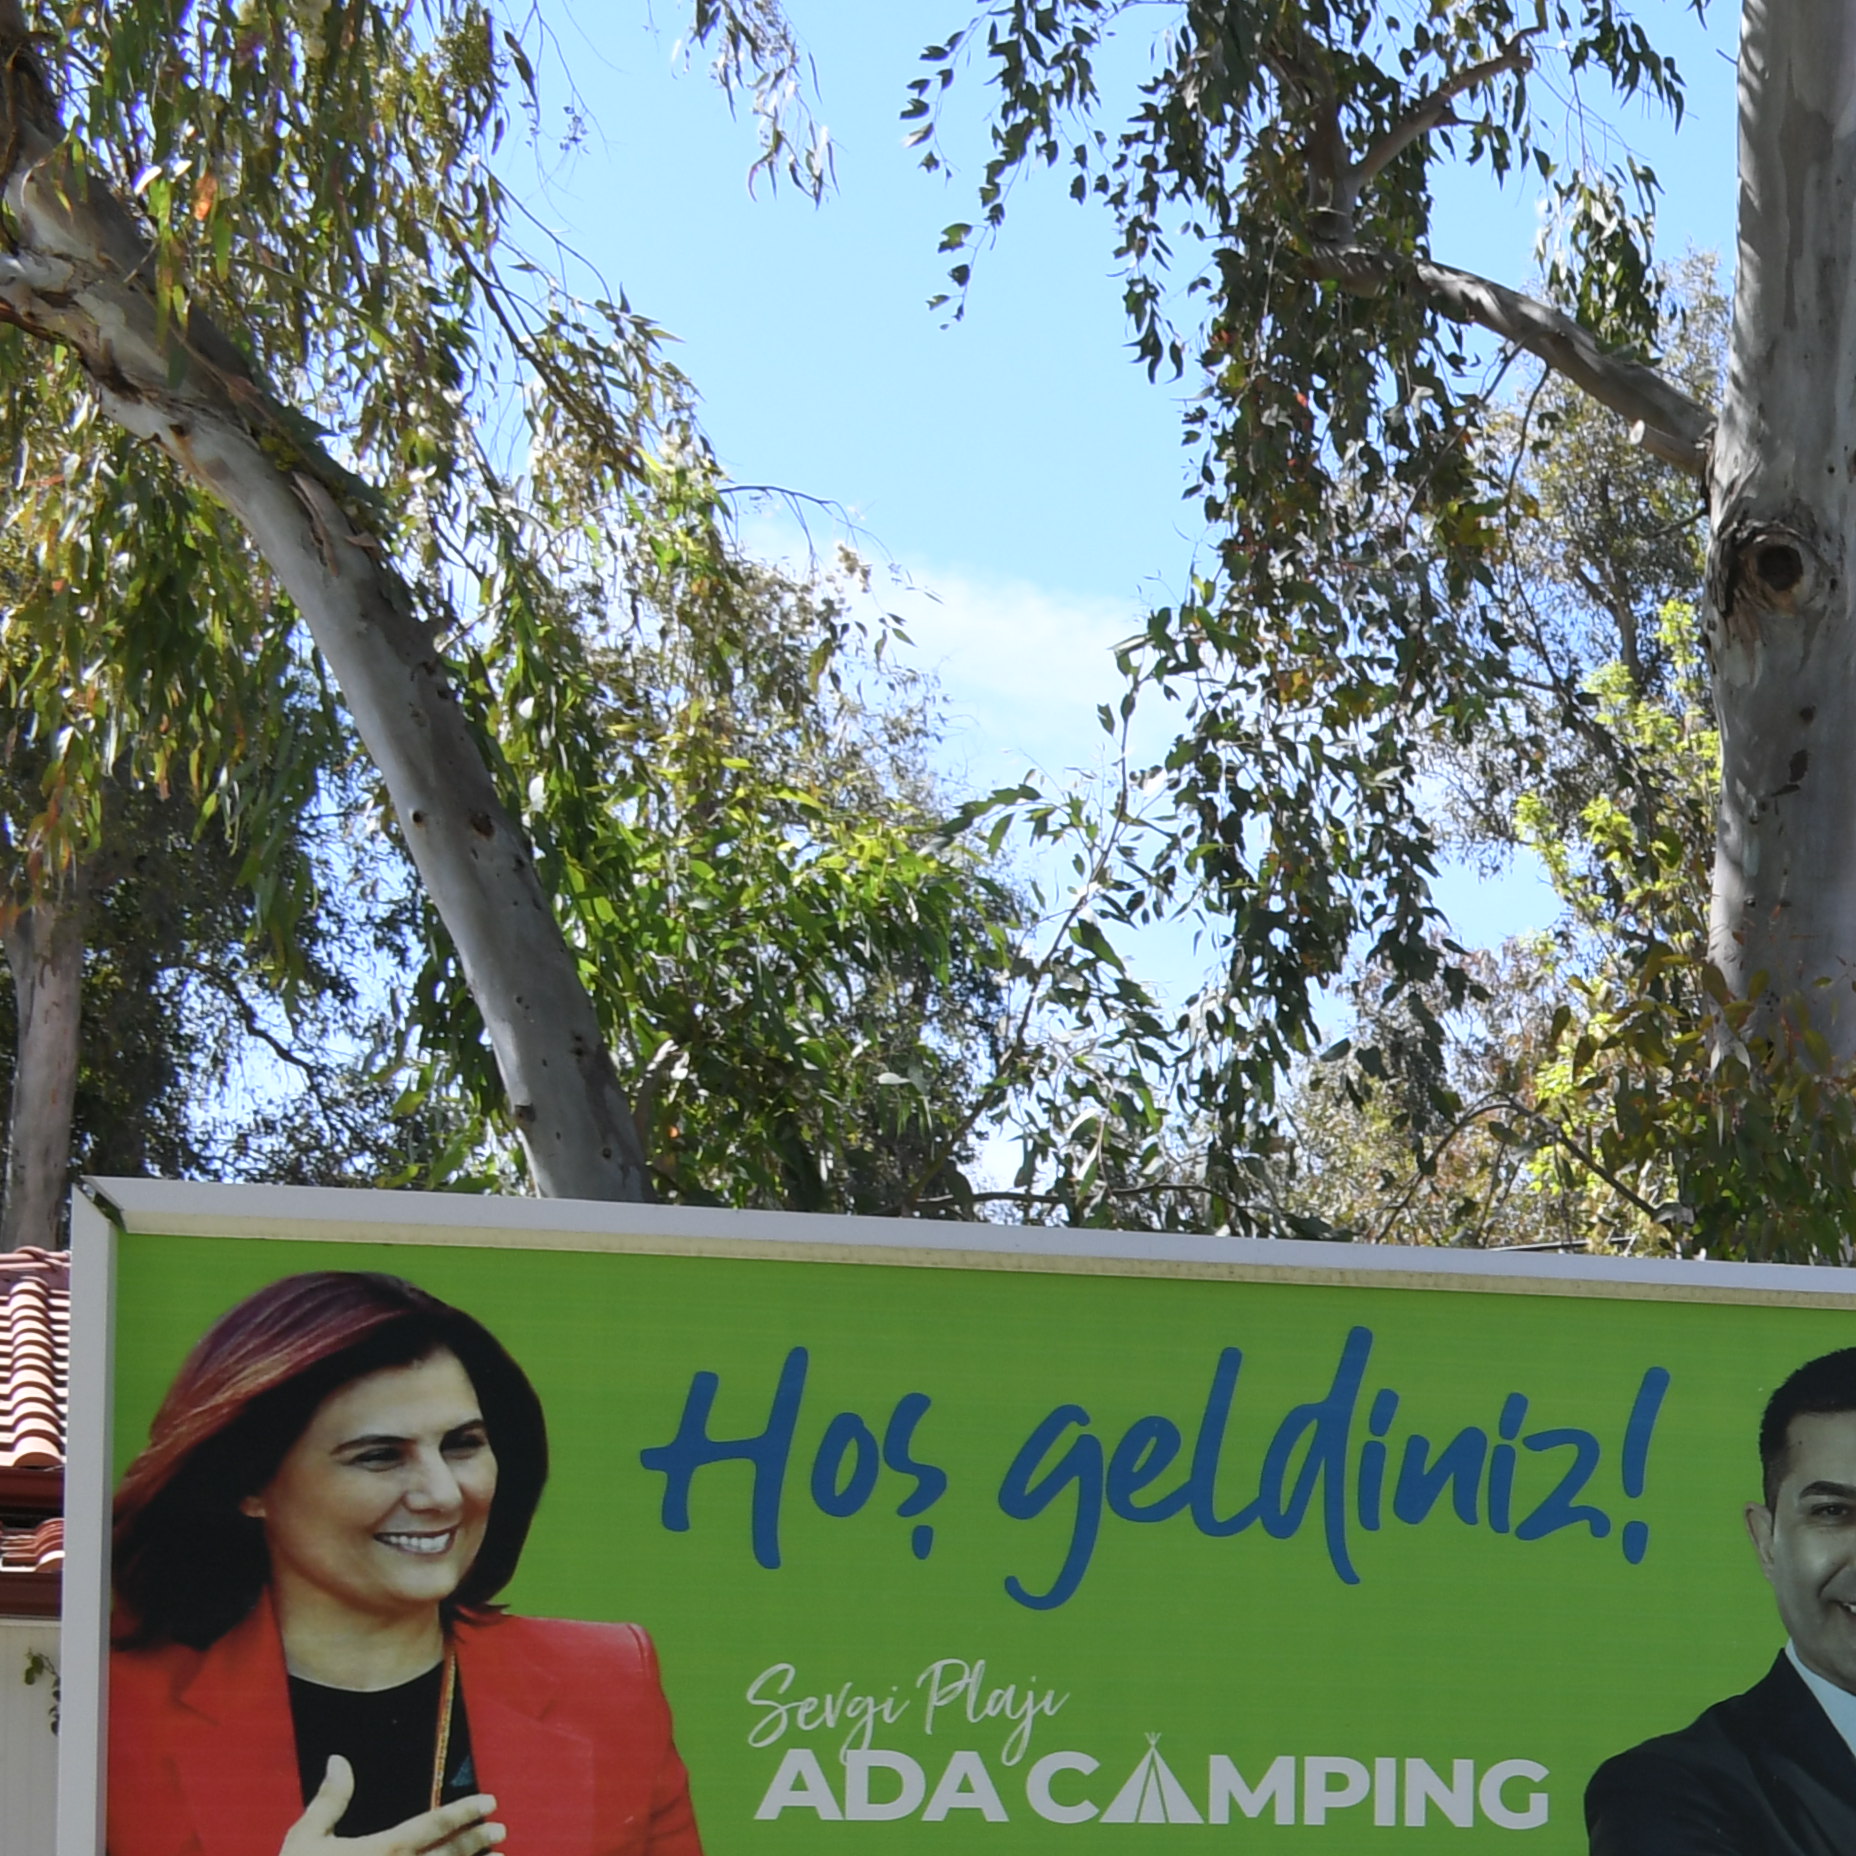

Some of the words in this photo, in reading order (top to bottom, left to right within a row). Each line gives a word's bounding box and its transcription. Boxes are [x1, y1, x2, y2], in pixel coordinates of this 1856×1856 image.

[640, 1346, 947, 1569] Hoş
[998, 1326, 1670, 1610] geldiniz!
[746, 1662, 907, 1765] Sevgi
[753, 1748, 1009, 1823] ADA
[1026, 1732, 1550, 1830] CAMPING
